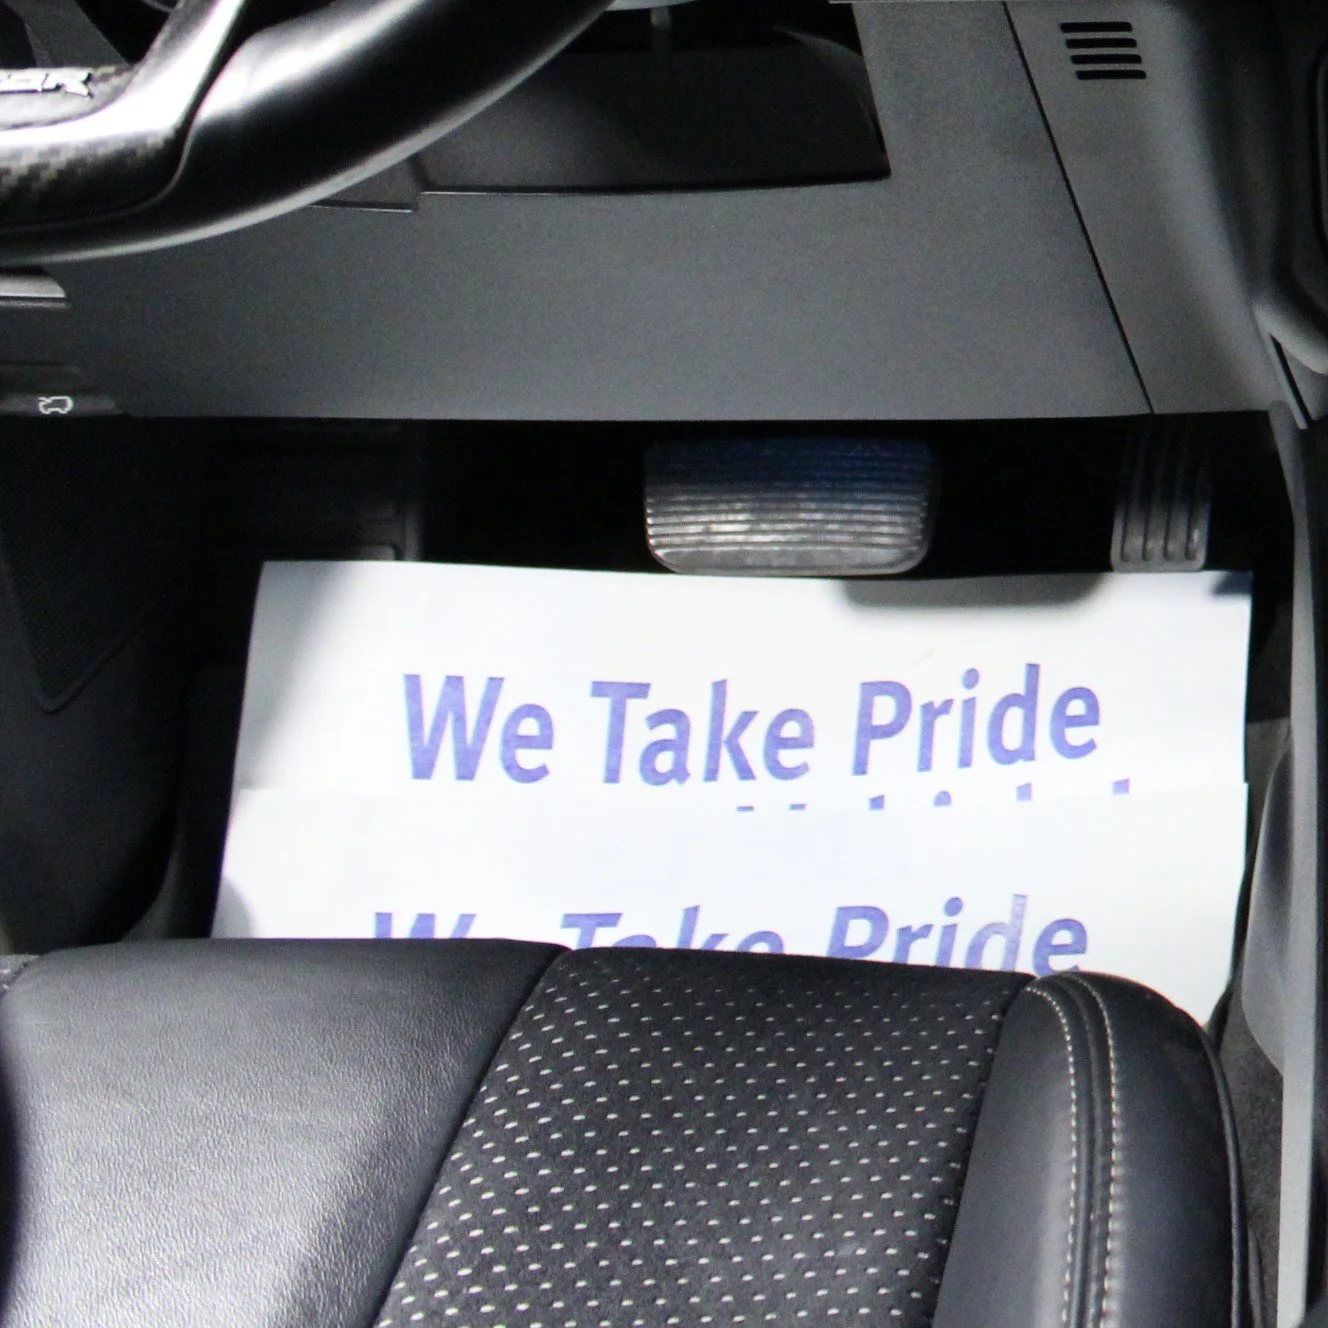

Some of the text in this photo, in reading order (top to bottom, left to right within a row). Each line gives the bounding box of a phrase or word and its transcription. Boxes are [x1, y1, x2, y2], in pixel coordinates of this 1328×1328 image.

[402, 662, 1102, 787] We Take Pride
